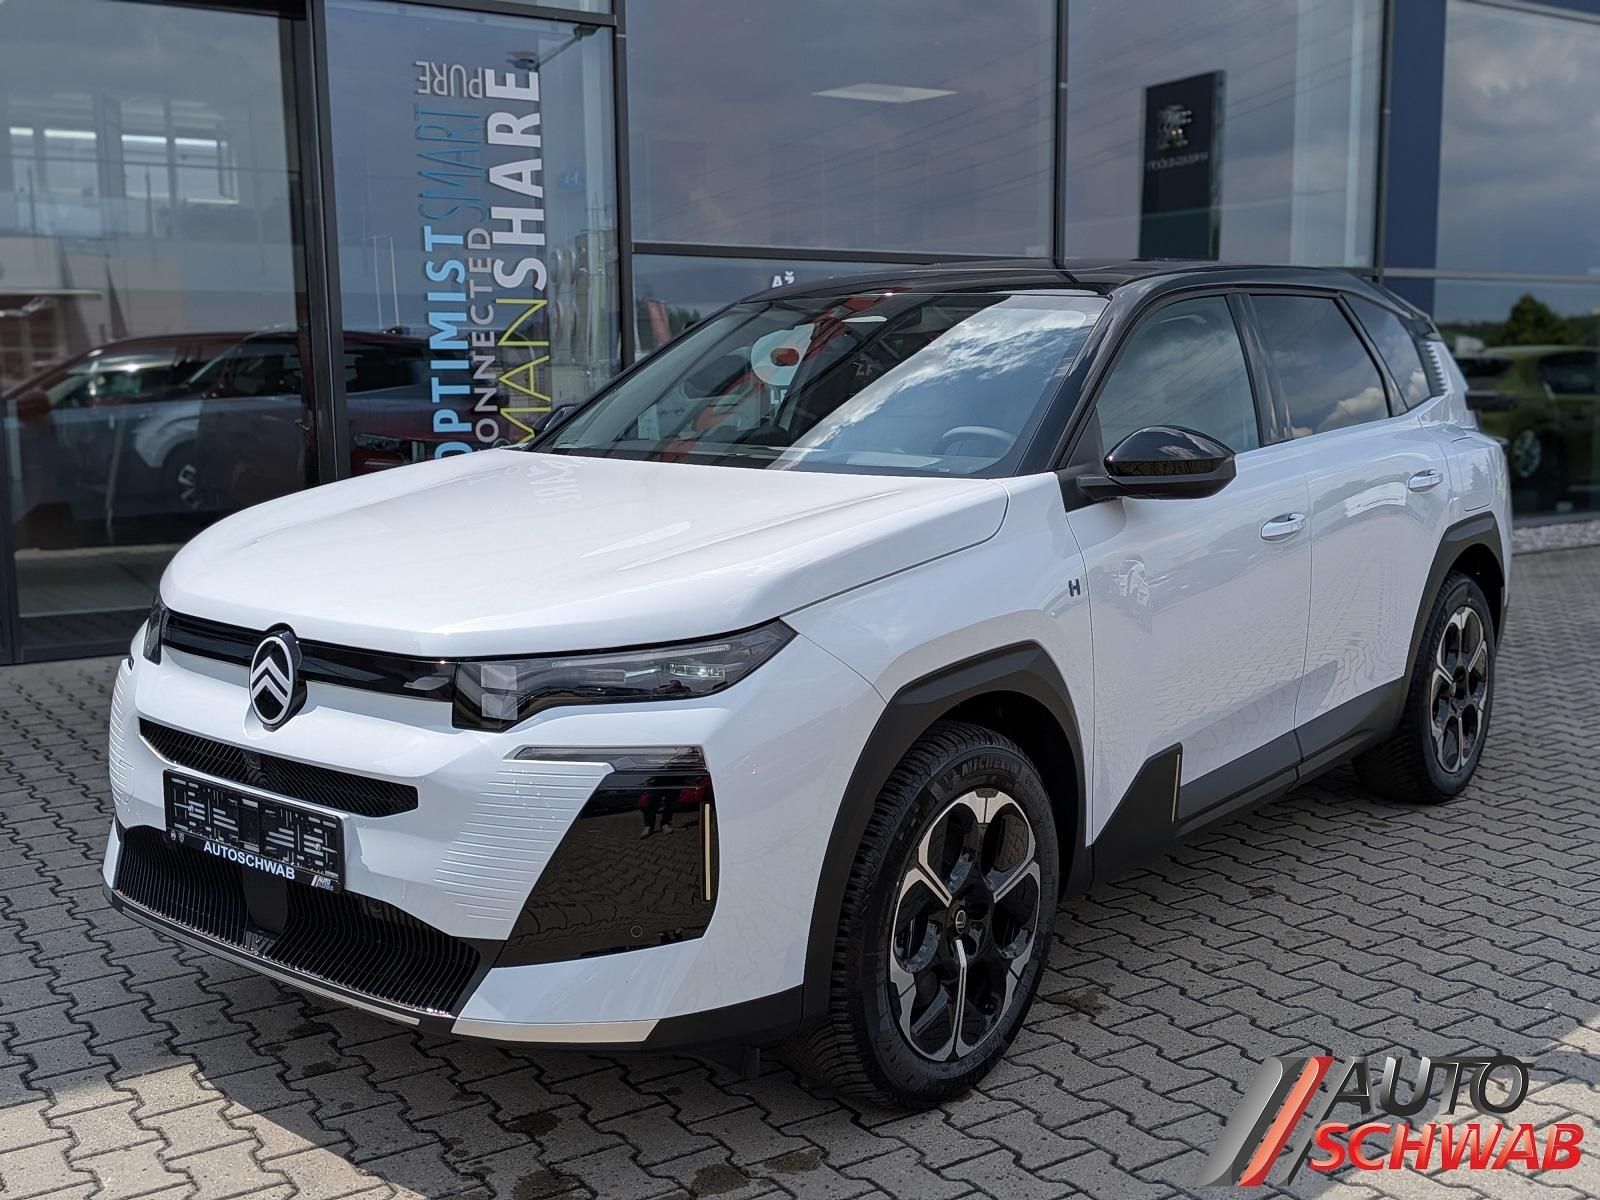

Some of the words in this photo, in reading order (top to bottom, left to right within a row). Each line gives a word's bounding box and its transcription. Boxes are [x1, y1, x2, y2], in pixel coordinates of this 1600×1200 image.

[415, 60, 485, 98] PURE
[415, 103, 488, 222] SMART
[484, 68, 547, 291] SHARE
[466, 227, 499, 450] ONNECTED
[1068, 578, 1081, 597] H
[203, 841, 296, 880] AUTOSCHWAB
